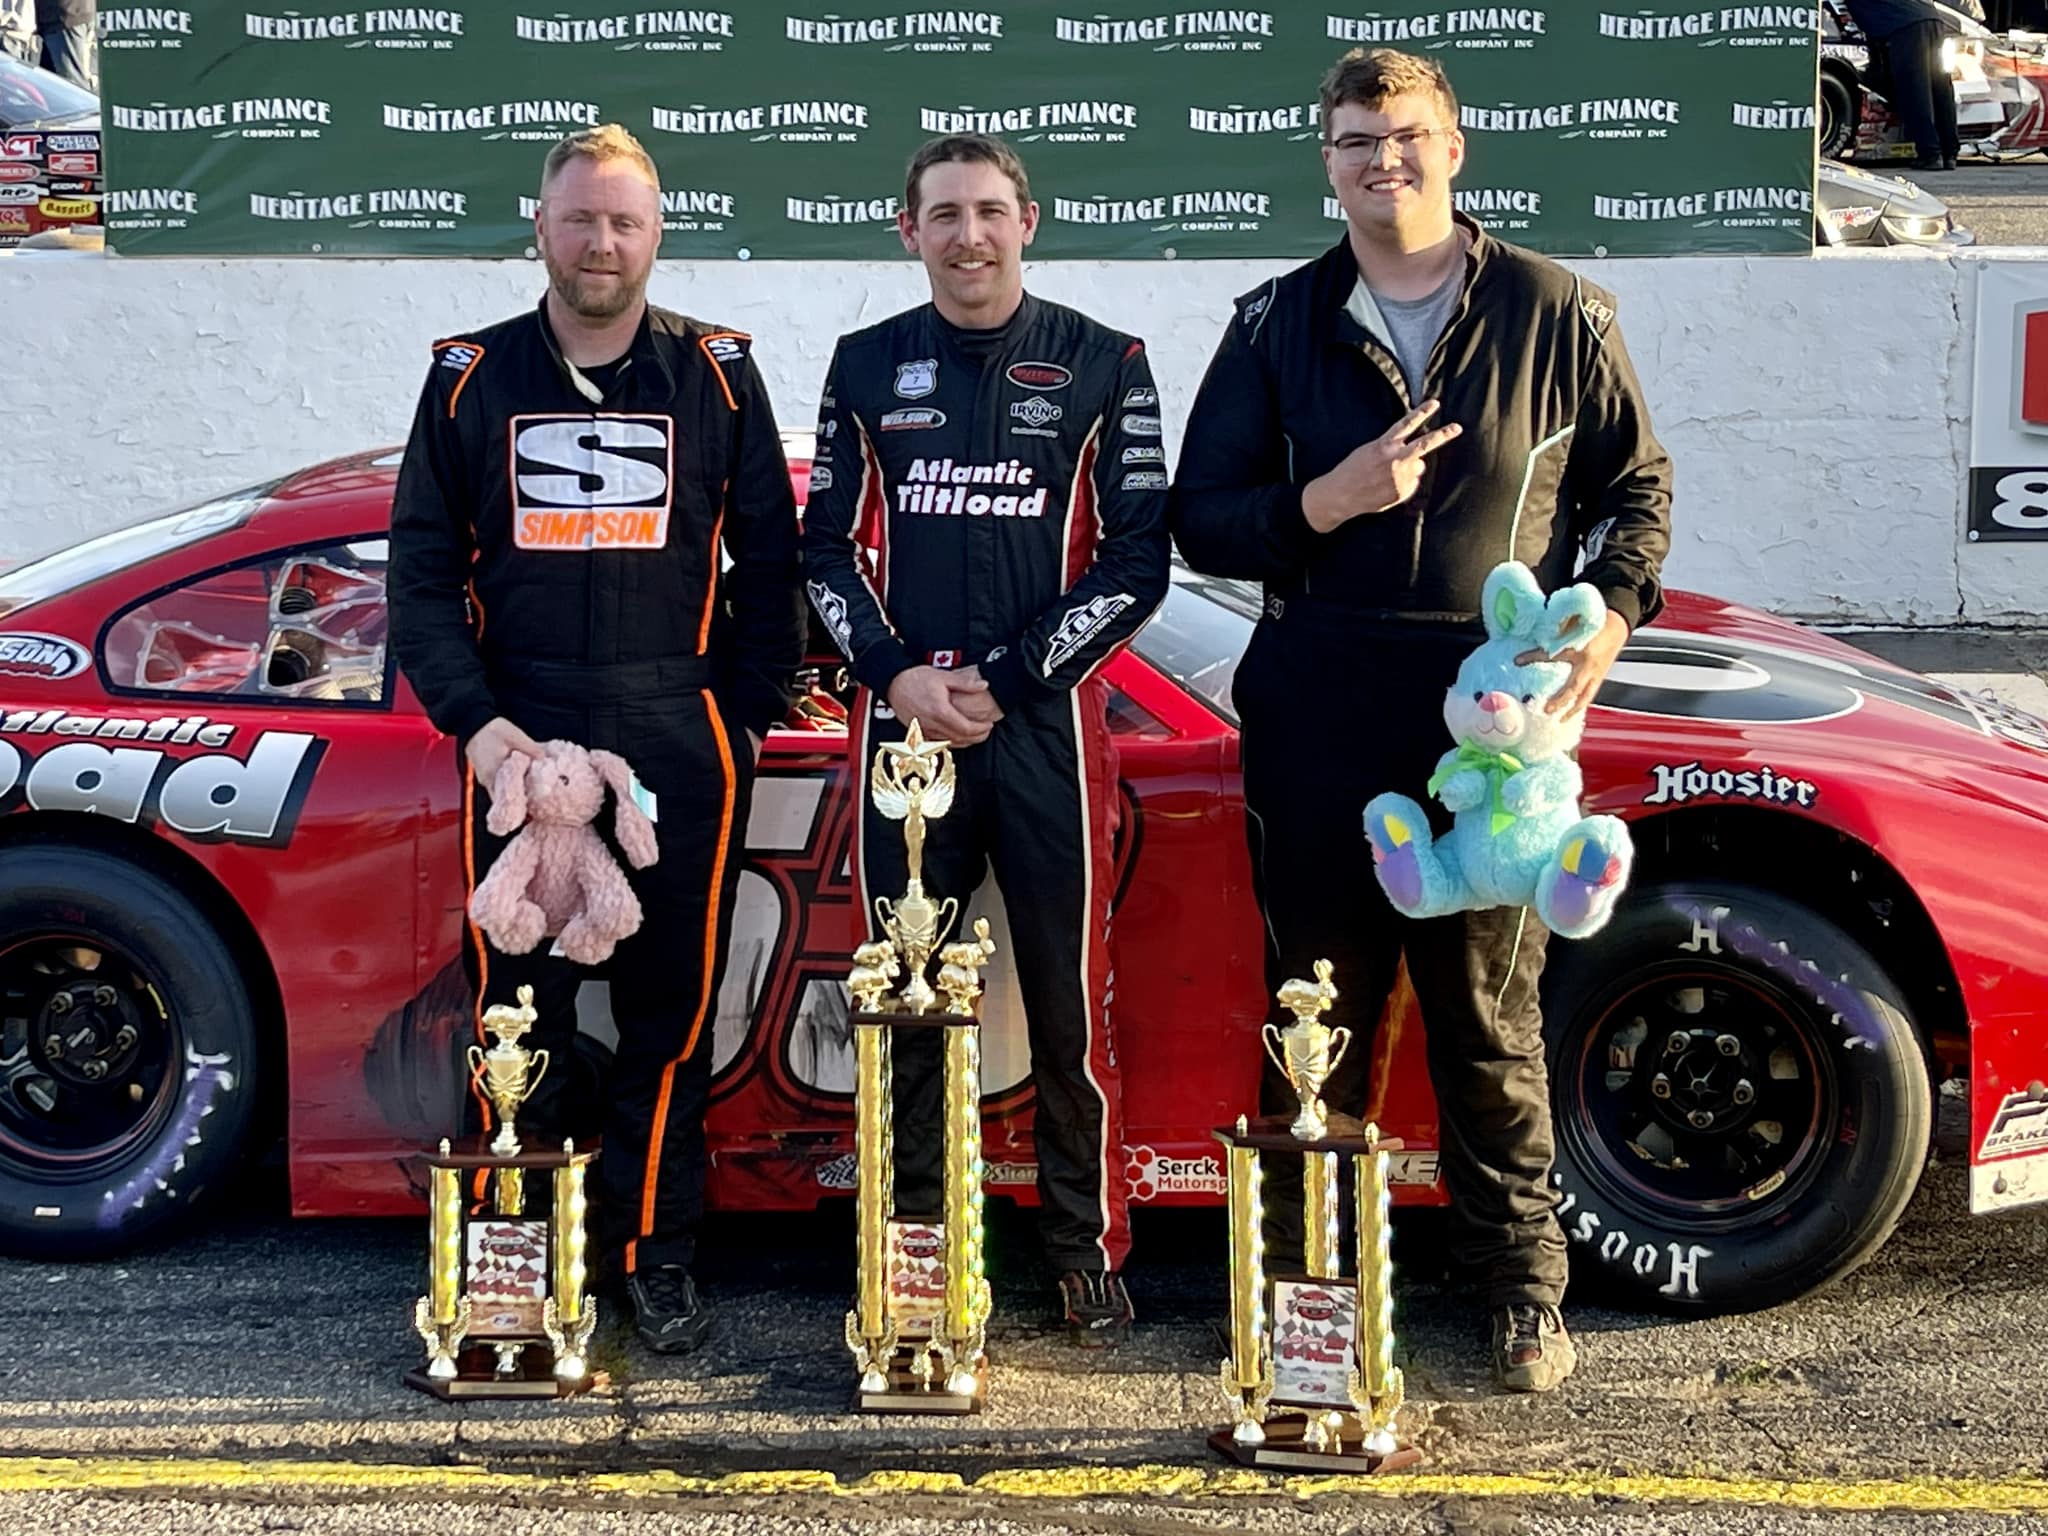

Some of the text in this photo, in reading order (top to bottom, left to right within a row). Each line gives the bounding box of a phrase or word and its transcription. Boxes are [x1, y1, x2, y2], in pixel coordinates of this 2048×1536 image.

[97, 9, 192, 34] FINANCE
[246, 8, 464, 40] HERITAGE FINANCE
[516, 11, 734, 42] HERITAGE FINANCE
[786, 12, 1003, 44] HERITAGE FINANCE
[1056, 11, 1273, 44] HERITAGE FINANCE
[1326, 9, 1546, 41] HERITAGE FINANCE
[1599, 7, 1818, 39] HERITAGE FINANCE
[103, 40, 182, 48] COMPANY INC
[374, 40, 453, 49] COMPANY INC
[644, 42, 722, 51] COMPANY INC
[914, 43, 992, 52] COMPANY INC
[1183, 42, 1262, 51] COMPANY INC
[1455, 39, 1534, 48] COMPANY INC
[1730, 37, 1809, 46] COMPANY INC
[112, 98, 331, 131] HERITAGE FINANCE
[383, 100, 600, 132] HERITAGE FINANCE
[652, 101, 869, 134] HERITAGE FINANCE
[921, 102, 1137, 135] HERITAGE FINANCE
[1189, 107, 1302, 134] HERITAGE
[1460, 98, 1679, 131] HERITAGE FINANCE
[242, 129, 321, 138] COMPANY INC
[511, 131, 565, 141] COMPANY
[779, 132, 857, 142] COMPANY INC
[1048, 132, 1126, 142] COMPANY INC
[1589, 129, 1668, 138] COMPANY INC
[103, 189, 198, 214] FINANCE
[250, 189, 467, 220] HERITAGE FINANCE
[787, 197, 899, 224] HERITAGE
[1054, 192, 1270, 224] HERITAGE FINANCE
[1452, 189, 1541, 215] INANCE
[1594, 187, 1812, 220] HERITAGE FINANCE
[108, 219, 186, 229] COMPANY INC
[378, 220, 456, 229] COMPANY INC
[703, 222, 724, 231] INC
[1181, 222, 1259, 231] COMPANY INC
[1509, 221, 1529, 229] INC
[1723, 218, 1801, 227] COMPANY INC
[1012, 403, 1062, 419] IRVING
[517, 421, 667, 506] S
[906, 458, 1034, 485] Atlantic
[897, 484, 1048, 516] Tiltload
[521, 511, 659, 545] SIMPSON
[0, 709, 236, 747] tlantic
[1644, 763, 1816, 806] Hoosier
[1157, 1159, 1217, 1175] Serck
